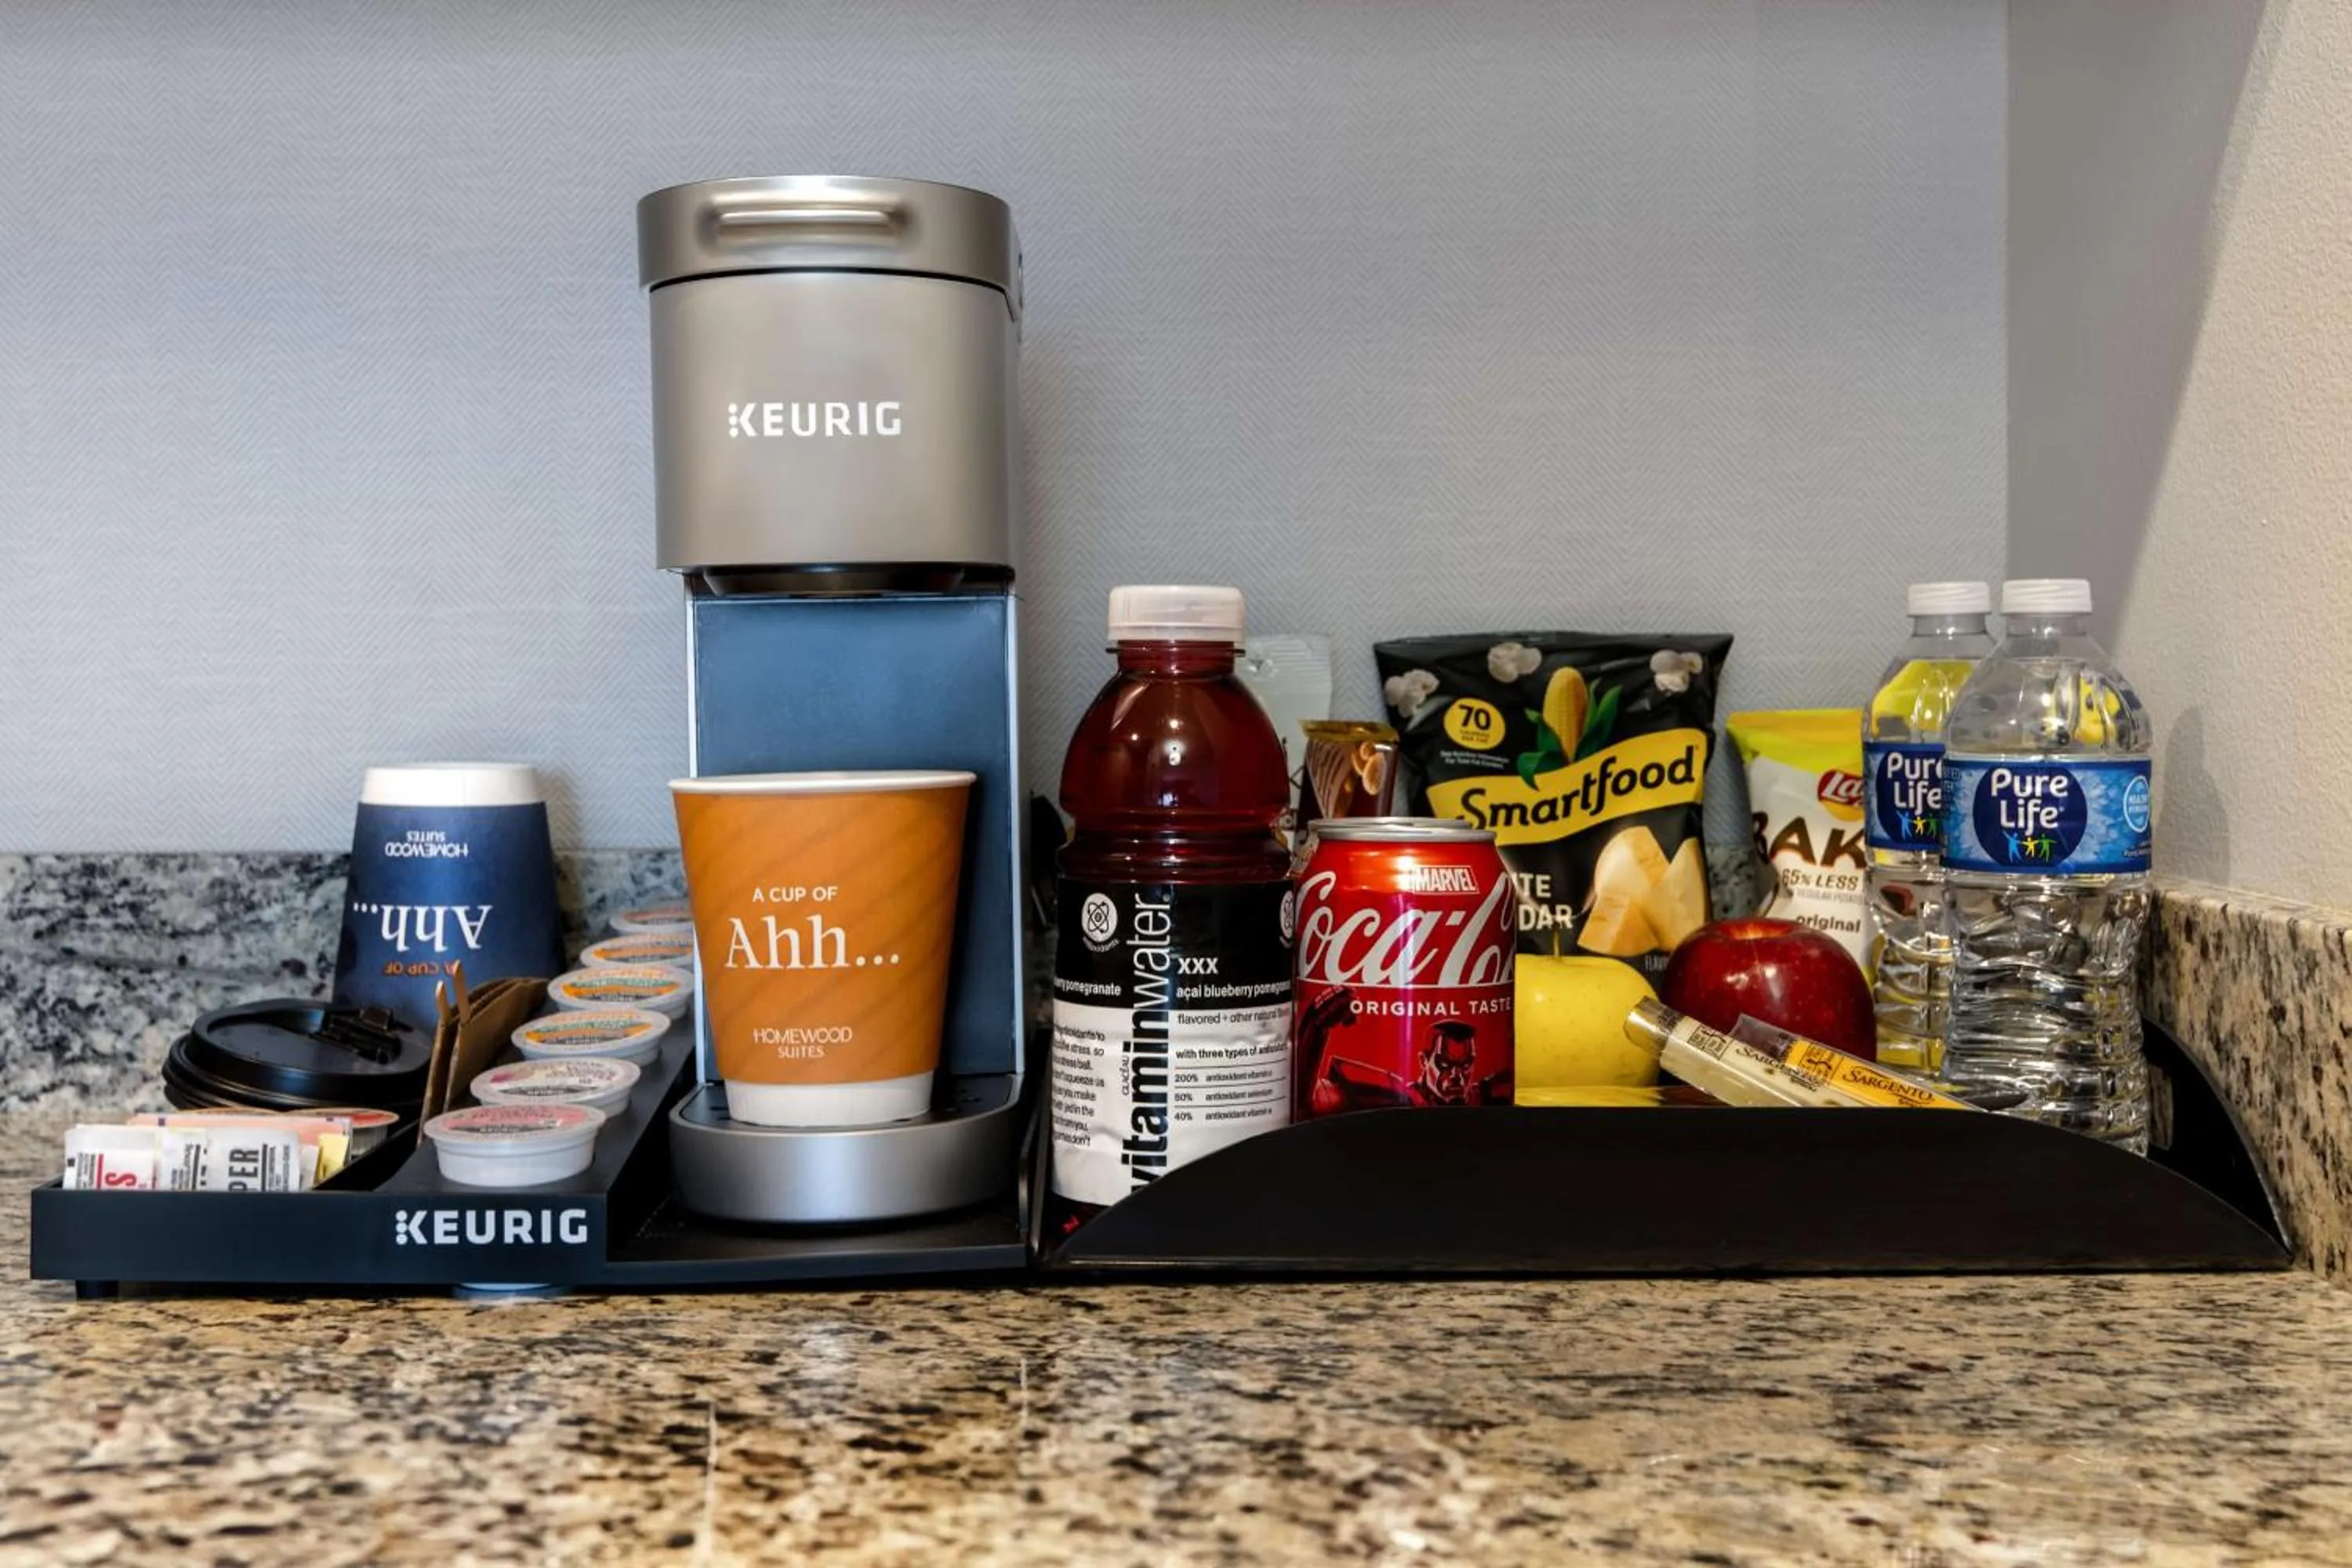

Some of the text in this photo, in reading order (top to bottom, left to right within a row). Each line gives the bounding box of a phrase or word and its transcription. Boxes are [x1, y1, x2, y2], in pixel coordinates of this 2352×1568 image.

[728, 401, 901, 437] KEURIG
[1458, 704, 1491, 730] 70
[1455, 745, 1695, 829] Smartfood
[1991, 768, 2068, 797] Pure
[1894, 781, 1941, 815] Life
[2000, 798, 2059, 836] Life
[406, 831, 446, 841] SUITES
[385, 842, 469, 858] HOMEWOOD
[1414, 868, 1477, 892] MARVEL
[1814, 874, 1859, 891] LESS
[753, 886, 838, 902] A CUP OF
[1796, 913, 1861, 933] original
[725, 915, 899, 969] Ahh...
[383, 961, 403, 975] OF
[408, 962, 439, 976] CUP
[1178, 957, 1218, 975] xxx
[1203, 982, 1254, 999] blueberry
[1350, 996, 1511, 1016] ORIGINAL TASTE
[1178, 1012, 1221, 1025] flavored
[753, 1026, 853, 1044] HOMEWOOD
[778, 1045, 824, 1058] SUITES
[1176, 1047, 1197, 1059] with
[1198, 1047, 1223, 1058] three
[1225, 1047, 1249, 1059] types
[1843, 1068, 1931, 1102] SARGENTO
[396, 1209, 587, 1245] KEURIG
